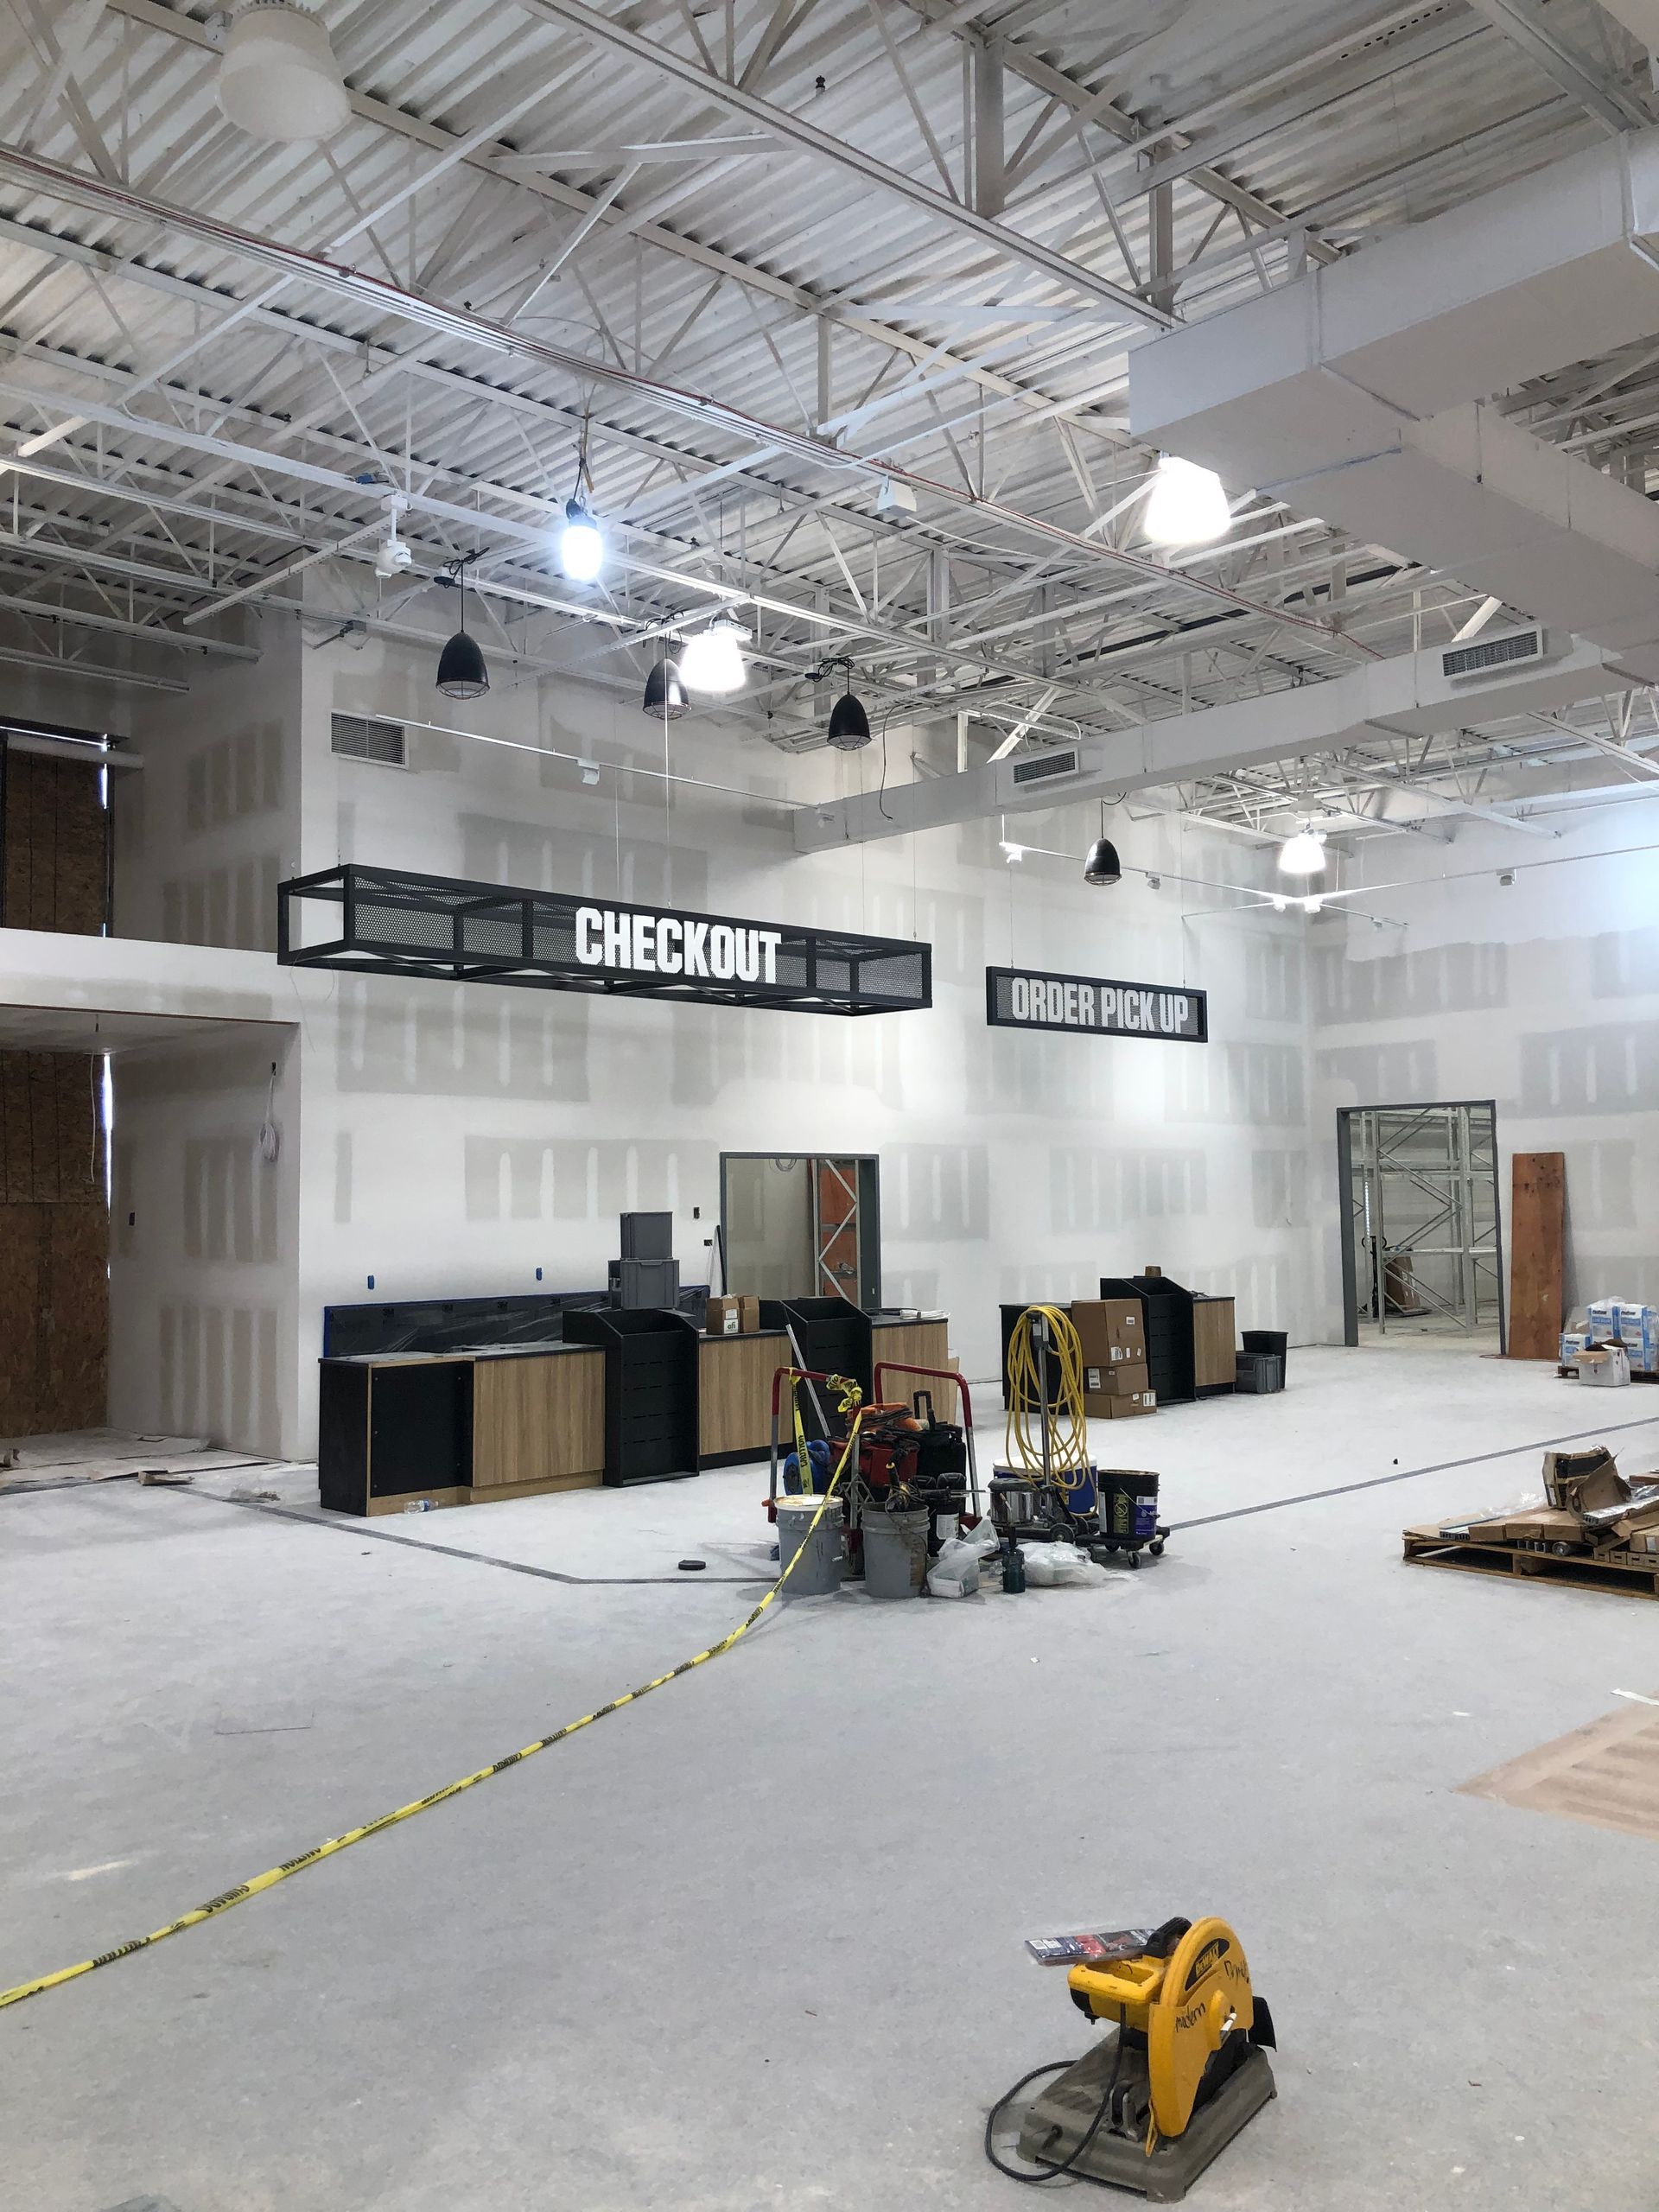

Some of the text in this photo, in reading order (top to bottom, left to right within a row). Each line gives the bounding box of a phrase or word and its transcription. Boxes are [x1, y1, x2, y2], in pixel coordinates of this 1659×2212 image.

[575, 906, 781, 984] CHECKOUT
[1012, 976, 1188, 1033] ORDER PICK UP
[798, 1434, 808, 1467] CAUTION
